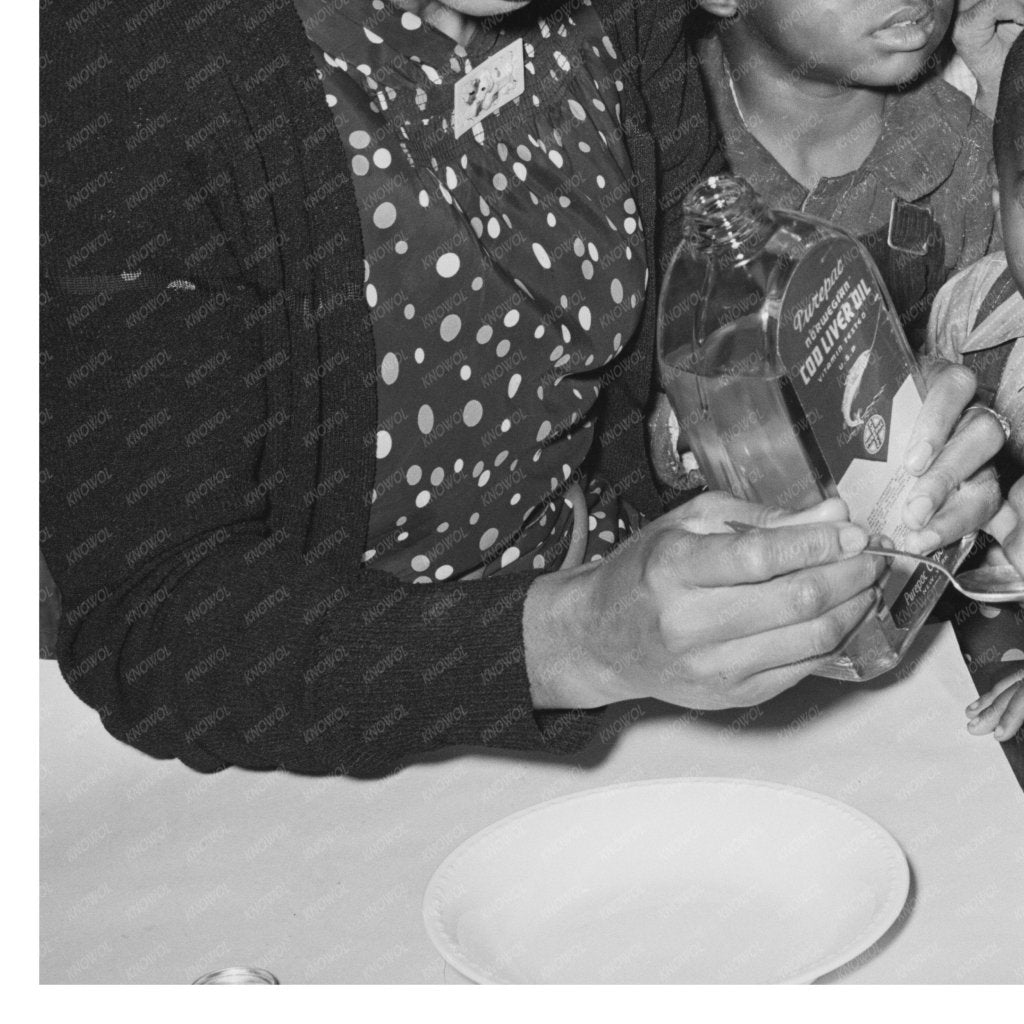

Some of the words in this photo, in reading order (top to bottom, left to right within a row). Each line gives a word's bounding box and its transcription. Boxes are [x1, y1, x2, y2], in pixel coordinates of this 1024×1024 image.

[799, 345, 824, 386] COD
[820, 301, 855, 355] LIVER
[850, 278, 872, 311] OIL
